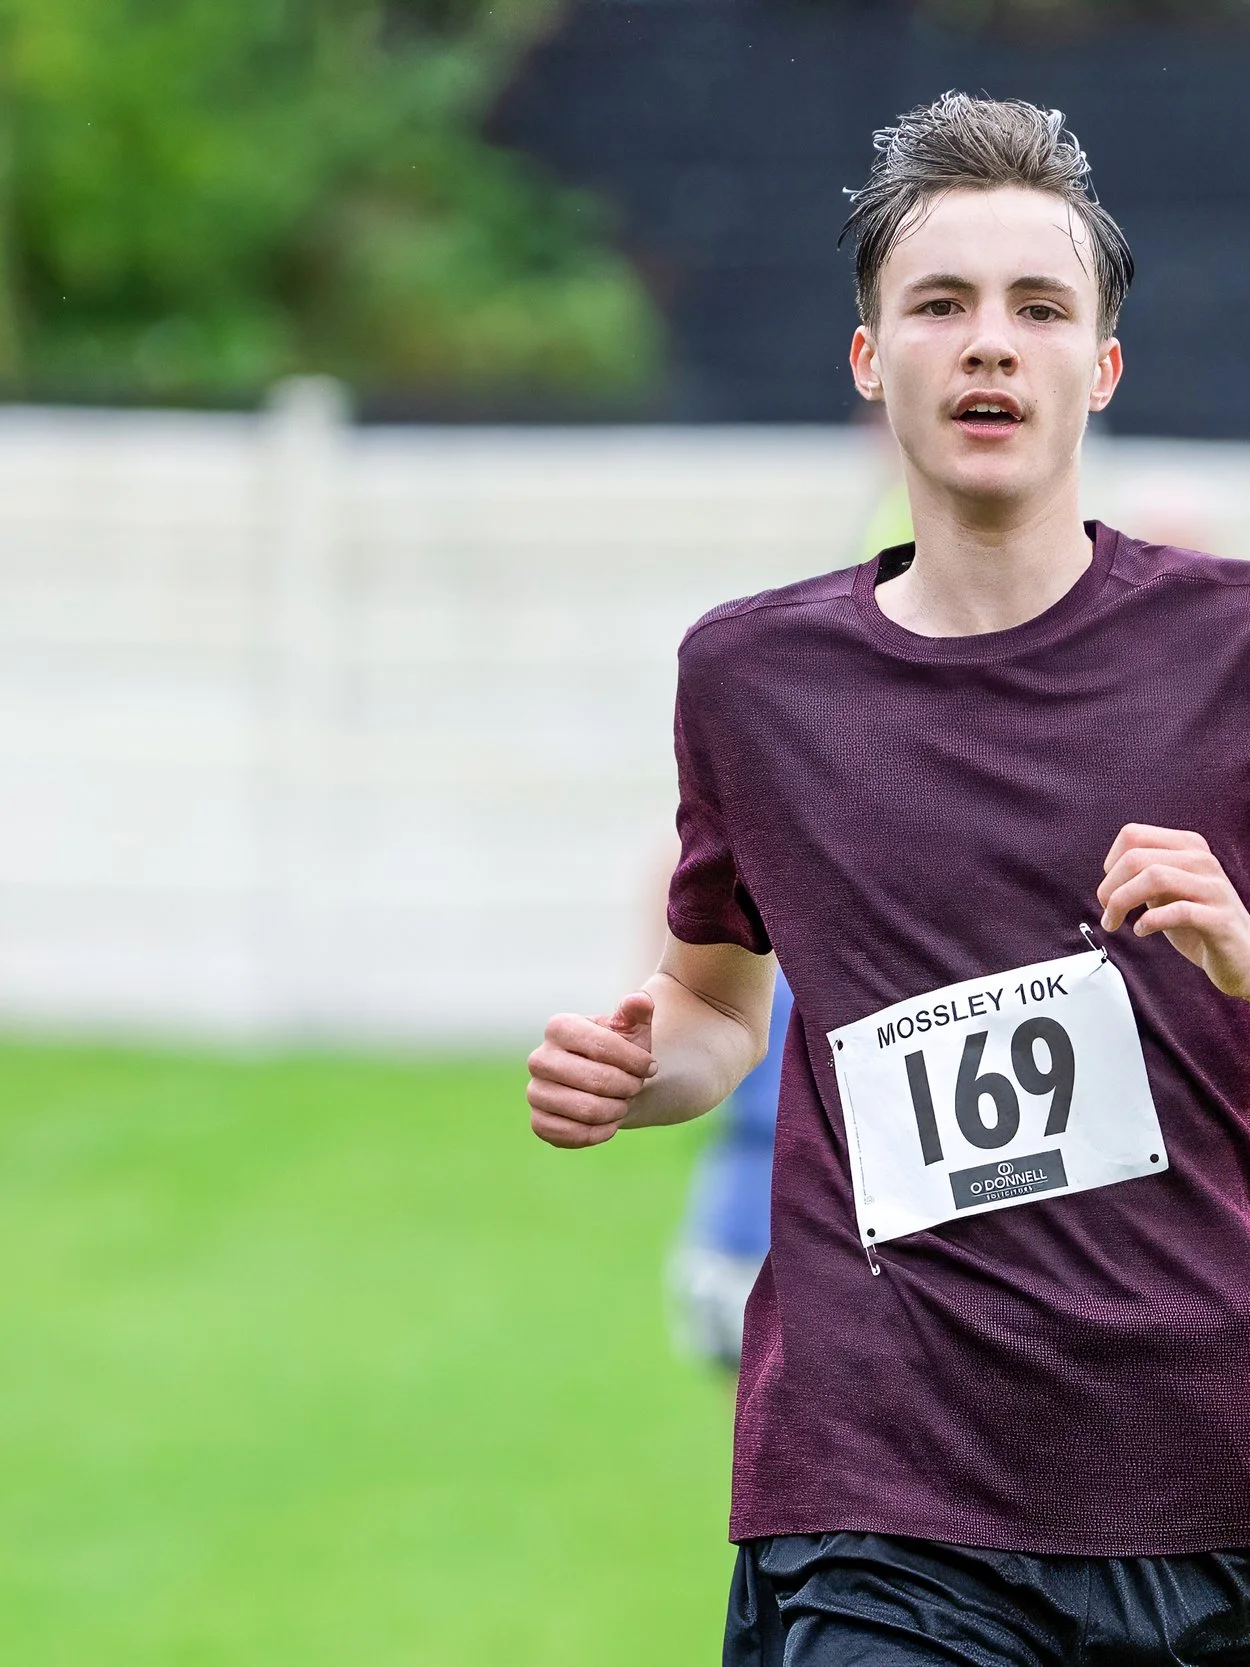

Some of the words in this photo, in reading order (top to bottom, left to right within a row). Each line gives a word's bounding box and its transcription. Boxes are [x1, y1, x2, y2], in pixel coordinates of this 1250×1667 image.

[877, 988, 1004, 1049] MOSSLEY
[1014, 974, 1069, 1005] 10K
[904, 1017, 1076, 1167] 169
[970, 1168, 1048, 1194] O'DONNELL
